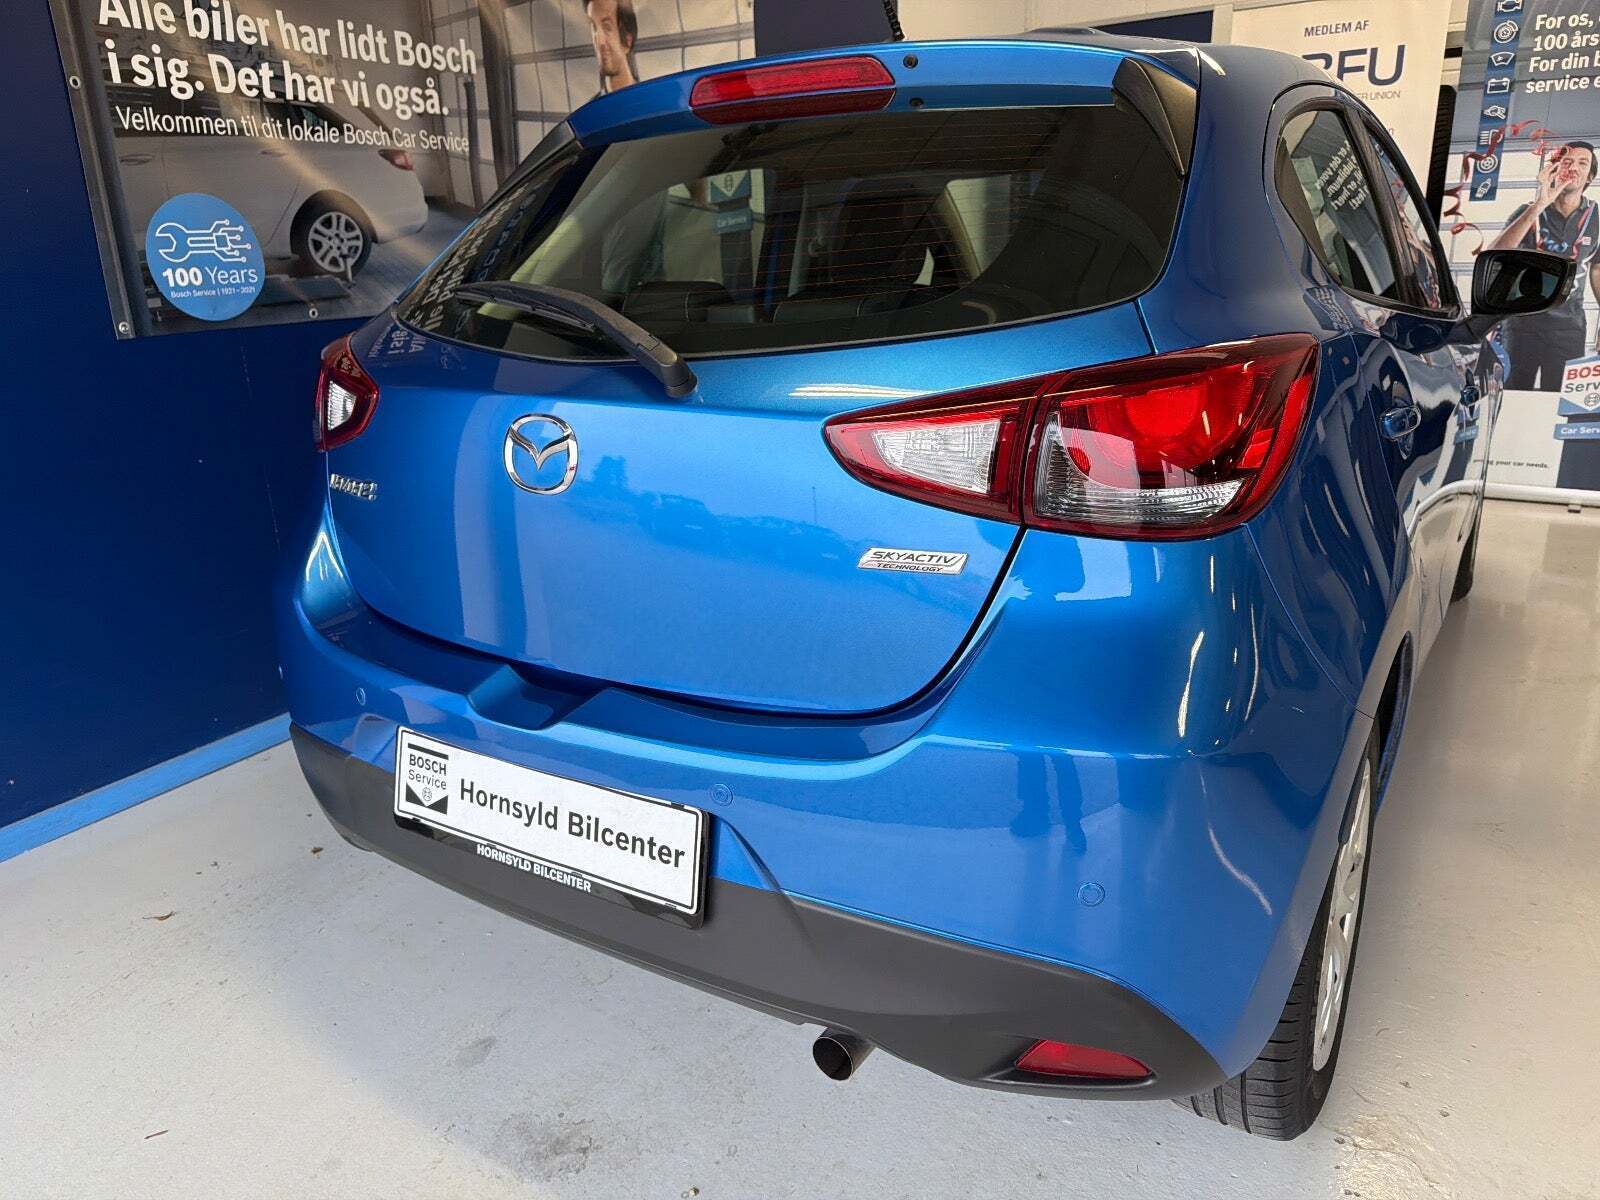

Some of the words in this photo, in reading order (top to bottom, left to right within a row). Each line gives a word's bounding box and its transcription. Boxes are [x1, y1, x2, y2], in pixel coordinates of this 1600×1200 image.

[1304, 21, 1352, 37] MEDLEM
[1354, 20, 1369, 31] AF
[1535, 13, 1565, 30] For
[1568, 13, 1594, 27] os,
[98, 0, 177, 34] Alle
[186, 0, 271, 47] biler
[277, 10, 330, 56] har
[337, 19, 390, 65] lidt
[393, 30, 478, 74] Bosch
[1533, 33, 1568, 51] 100
[1570, 30, 1600, 48] års
[1528, 56, 1559, 72] For
[1561, 52, 1590, 70] din
[105, 38, 122, 85] i
[131, 43, 205, 100] sig.
[207, 52, 277, 100] Det
[283, 60, 336, 109] har
[342, 71, 370, 108] vi
[376, 77, 450, 121] også.
[1525, 74, 1590, 93] service
[1370, 90, 1401, 100] UNION
[115, 105, 238, 137] Velkommen
[240, 114, 259, 138] til
[261, 116, 285, 140] dit
[287, 117, 340, 143] lokale
[344, 123, 391, 147] Bosch
[392, 126, 417, 149] Car
[419, 129, 470, 152] Service
[162, 266, 203, 287] 100
[204, 265, 258, 285] Years
[171, 289, 192, 299] Bosch
[870, 551, 956, 564] SKYACTIV
[876, 562, 943, 572] TECHNOLOGY
[408, 753, 447, 776] BOSCH
[408, 768, 447, 791] Service
[459, 778, 559, 830] Hornsyld
[568, 811, 686, 868] Bilcenter
[476, 843, 532, 873] HORNSYLD
[533, 862, 593, 893] BILCENTER
